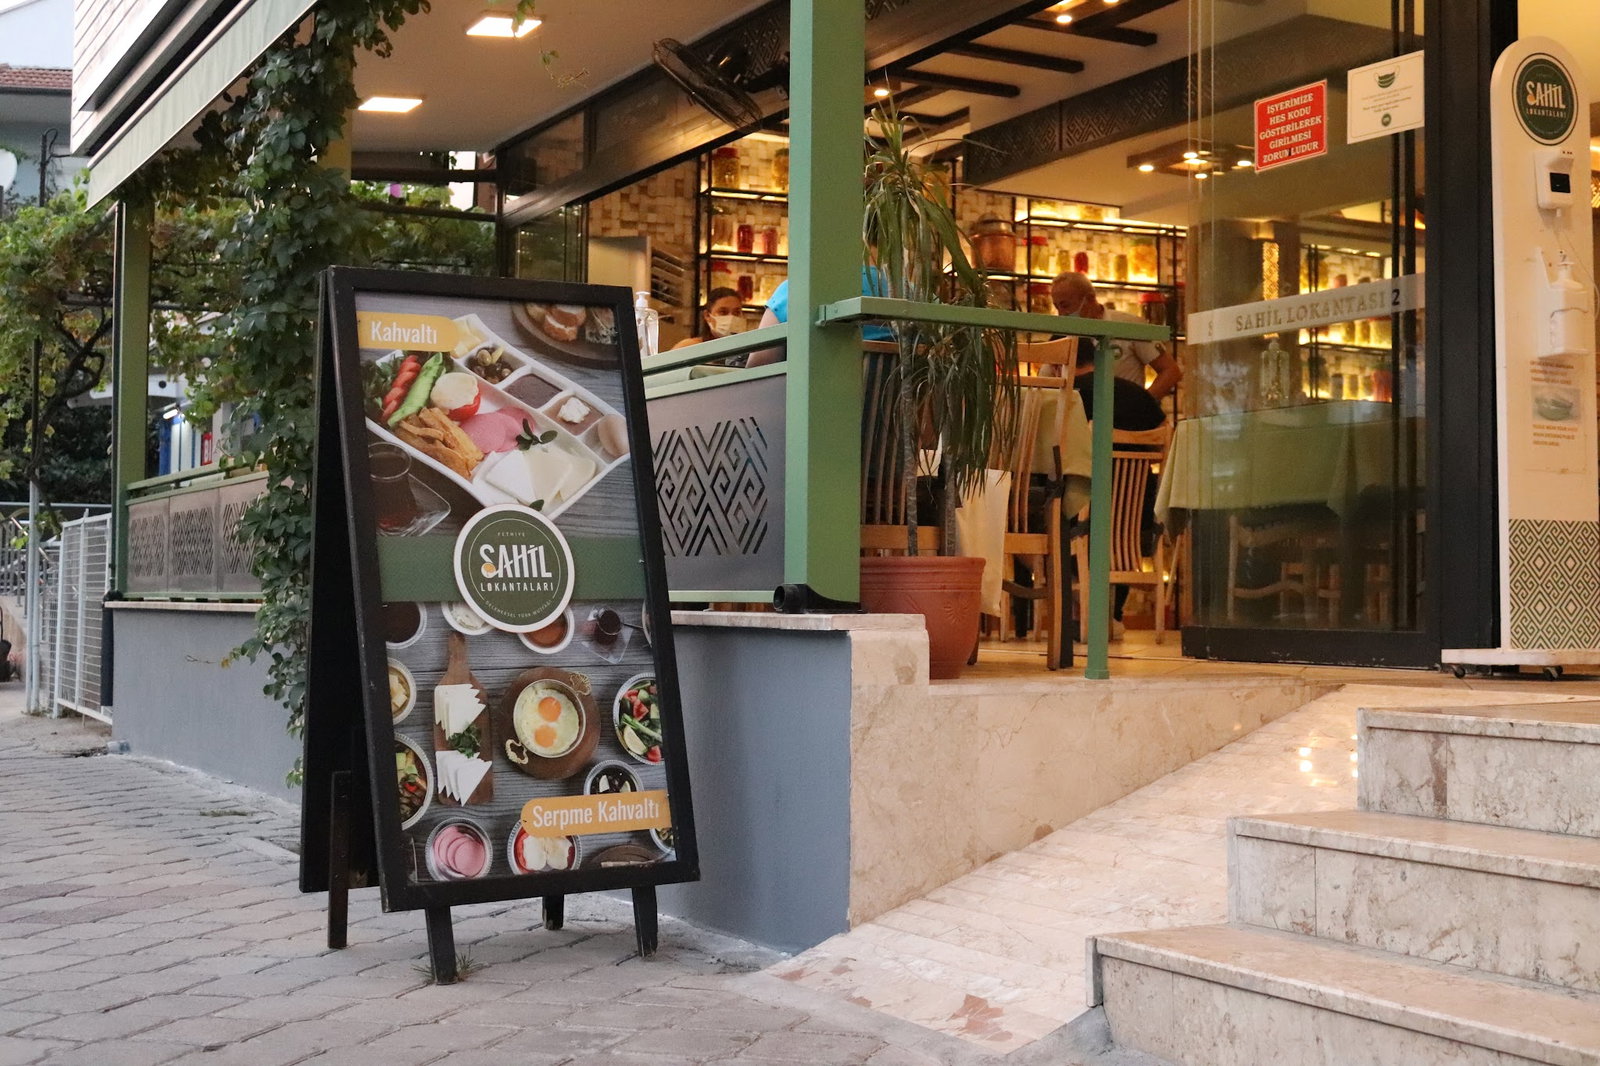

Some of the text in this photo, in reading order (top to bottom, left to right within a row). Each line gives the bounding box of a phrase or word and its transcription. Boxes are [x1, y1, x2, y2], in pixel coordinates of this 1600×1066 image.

[1259, 115, 1322, 140] GÖSTERİLEREK
[1269, 106, 1312, 125] HES KODU
[1263, 141, 1319, 163] ZORUNLUDUR
[1269, 130, 1312, 149] GİRİLMESİ
[1236, 288, 1400, 332] SAHİL LOKANTASI 2
[371, 320, 437, 345] Kahvaltı
[480, 543, 553, 579] SAHİL
[480, 582, 554, 592] LOKANTALARI
[532, 797, 660, 830] Serpme Kahvaltı
